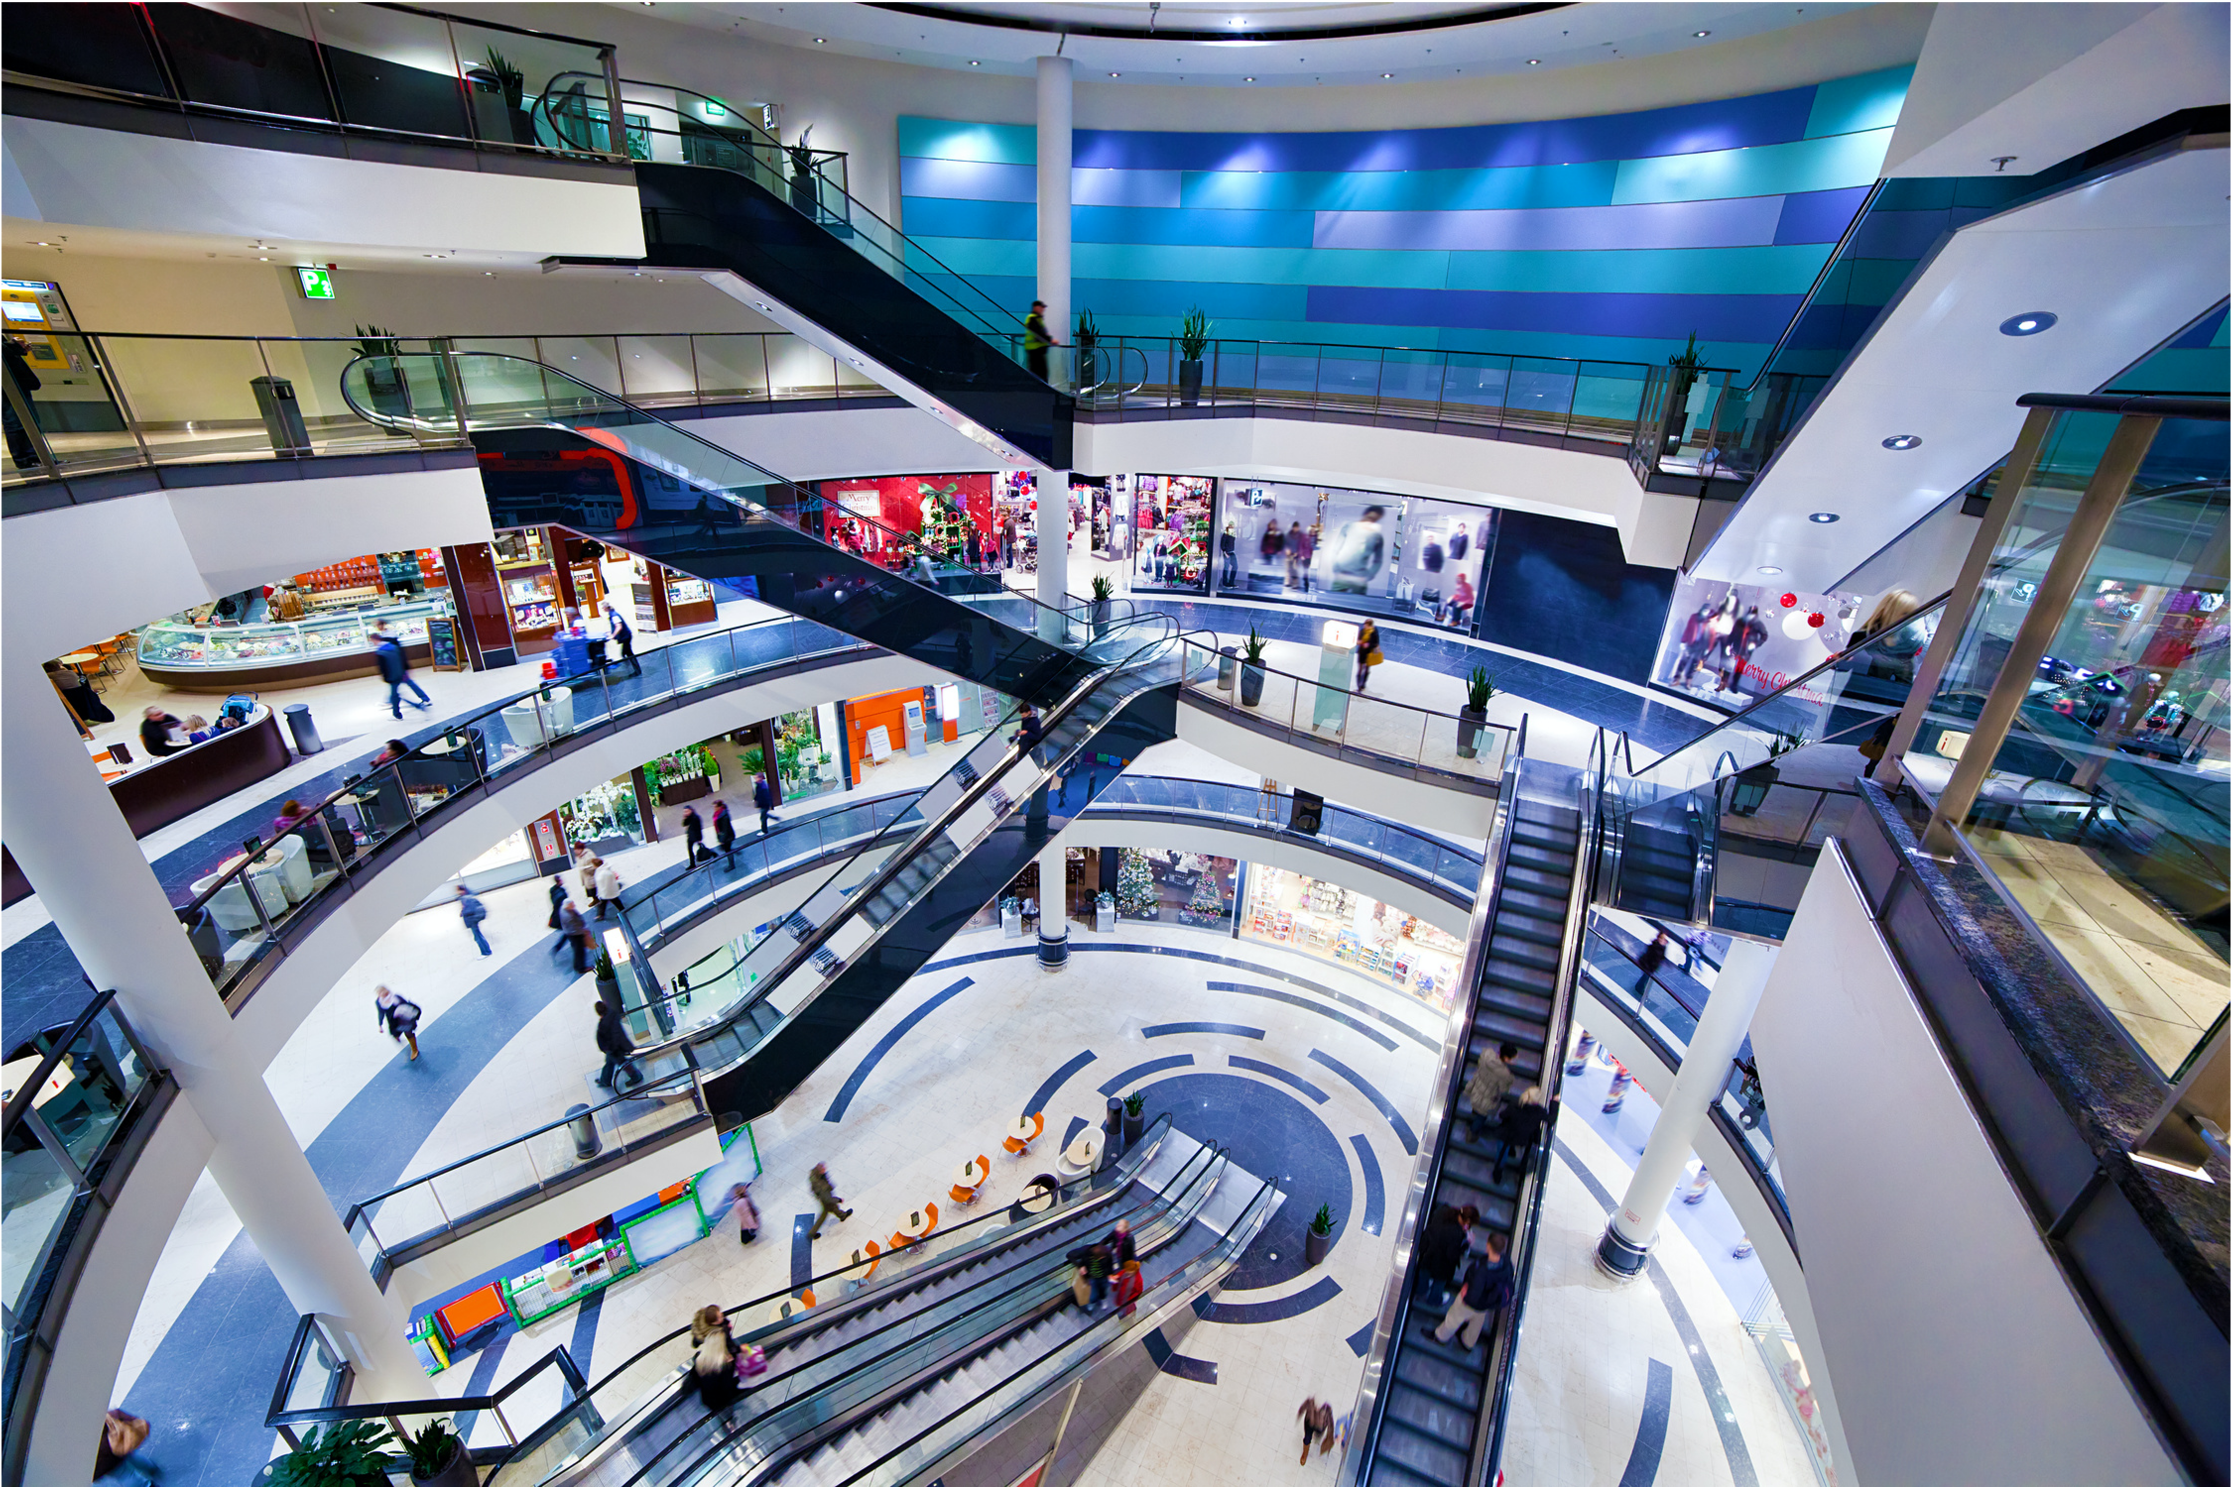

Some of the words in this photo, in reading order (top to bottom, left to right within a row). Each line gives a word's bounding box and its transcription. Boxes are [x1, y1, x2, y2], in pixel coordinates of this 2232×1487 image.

[302, 271, 319, 291] P
[846, 493, 871, 504] Merry
[1734, 654, 1770, 690] Merry
[1940, 737, 1948, 751] i
